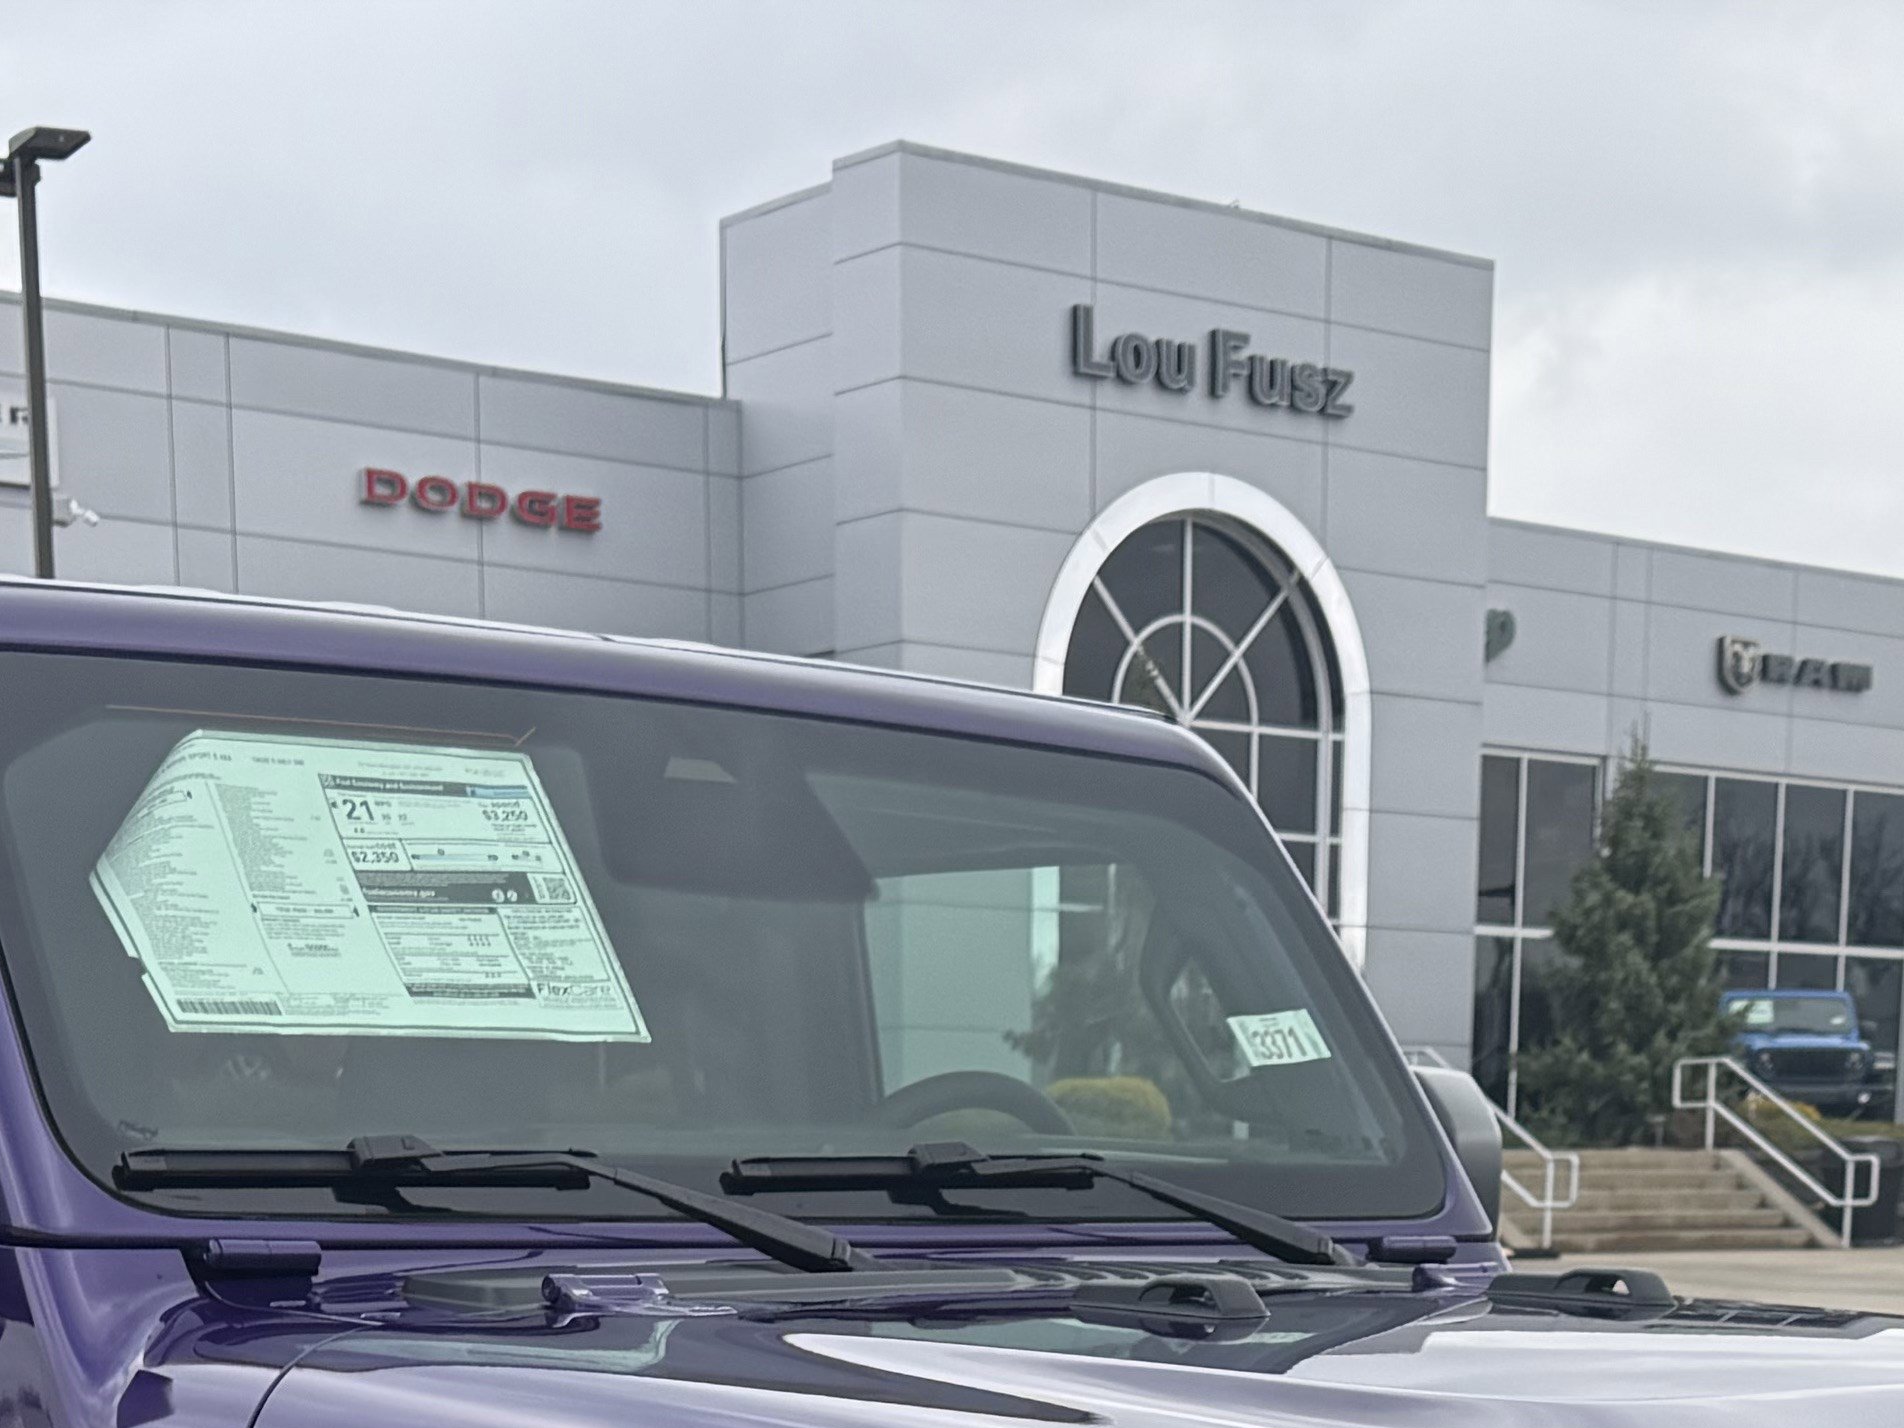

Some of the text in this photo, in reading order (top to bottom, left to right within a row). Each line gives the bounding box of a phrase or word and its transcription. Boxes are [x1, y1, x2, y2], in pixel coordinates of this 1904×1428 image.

[1070, 303, 1354, 419] Lou Fusz
[360, 466, 603, 533] DODGE
[342, 798, 375, 822] 21
[1251, 1027, 1308, 1060] 3371
